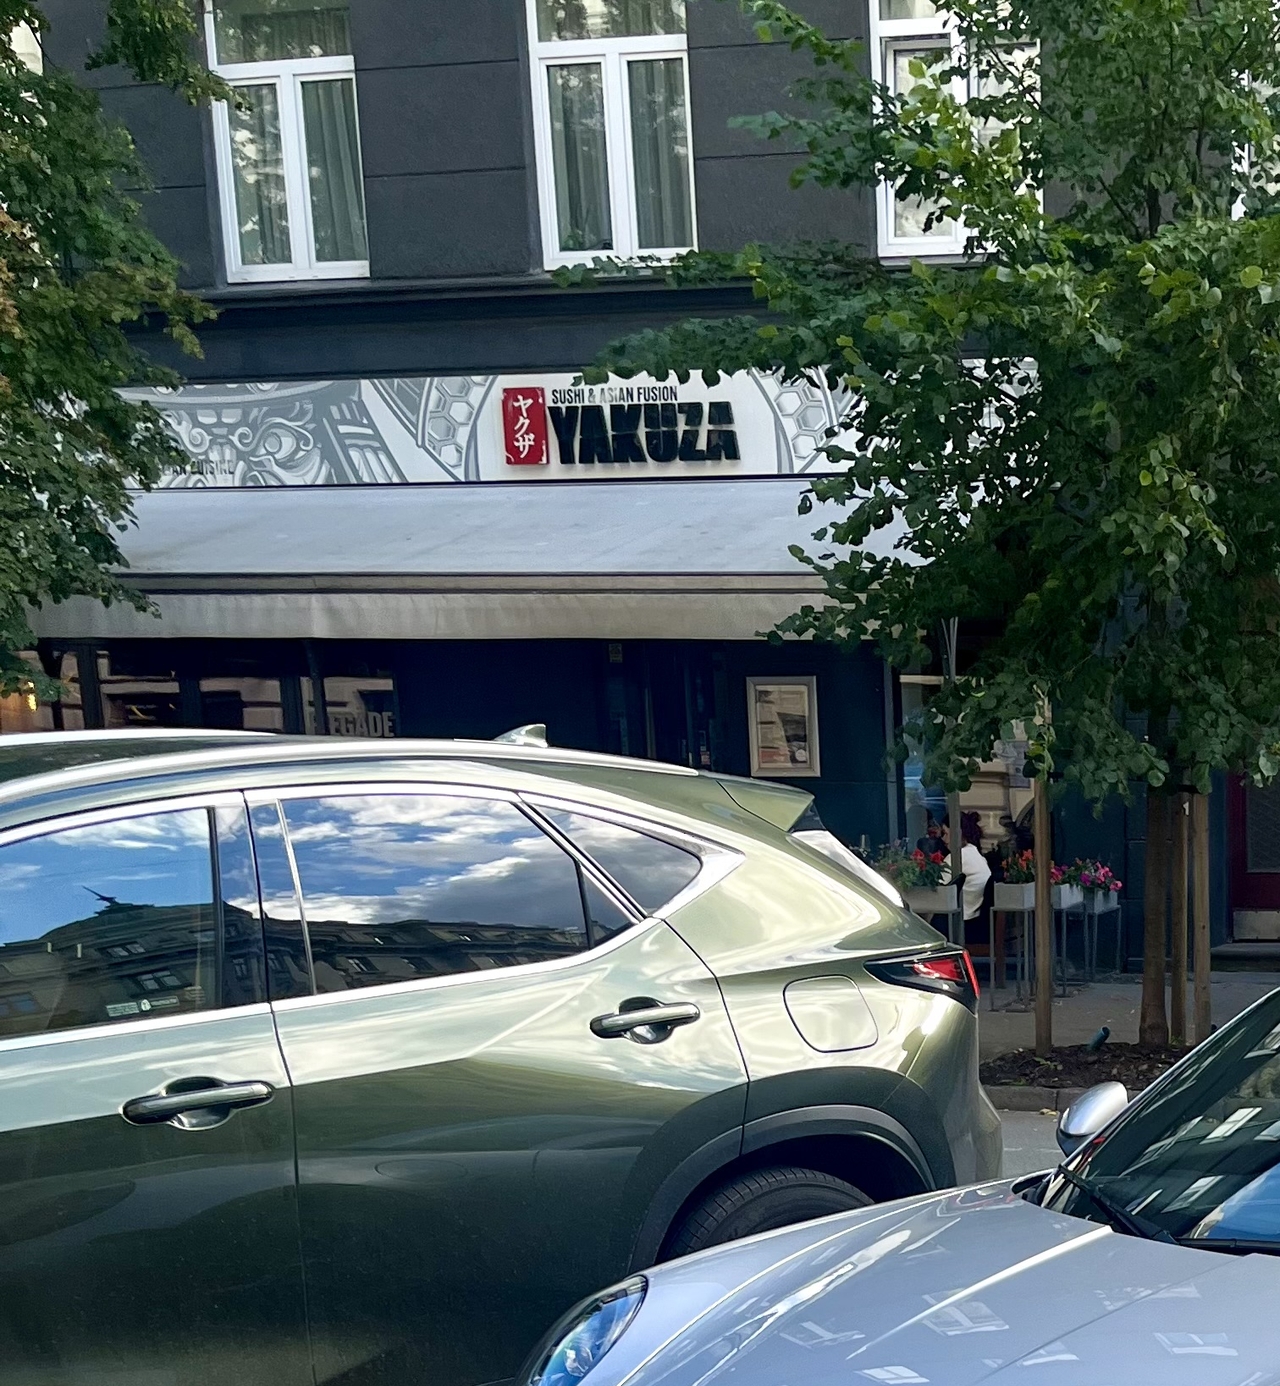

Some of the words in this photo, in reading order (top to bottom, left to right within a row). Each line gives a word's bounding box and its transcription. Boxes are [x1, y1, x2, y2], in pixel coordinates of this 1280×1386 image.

[551, 388, 585, 404] SUSHI
[587, 388, 597, 404] &
[600, 386, 634, 403] ASIAN
[636, 385, 678, 402] FUSION
[512, 395, 536, 459] ヤクザ
[547, 401, 741, 465] YAKUZA
